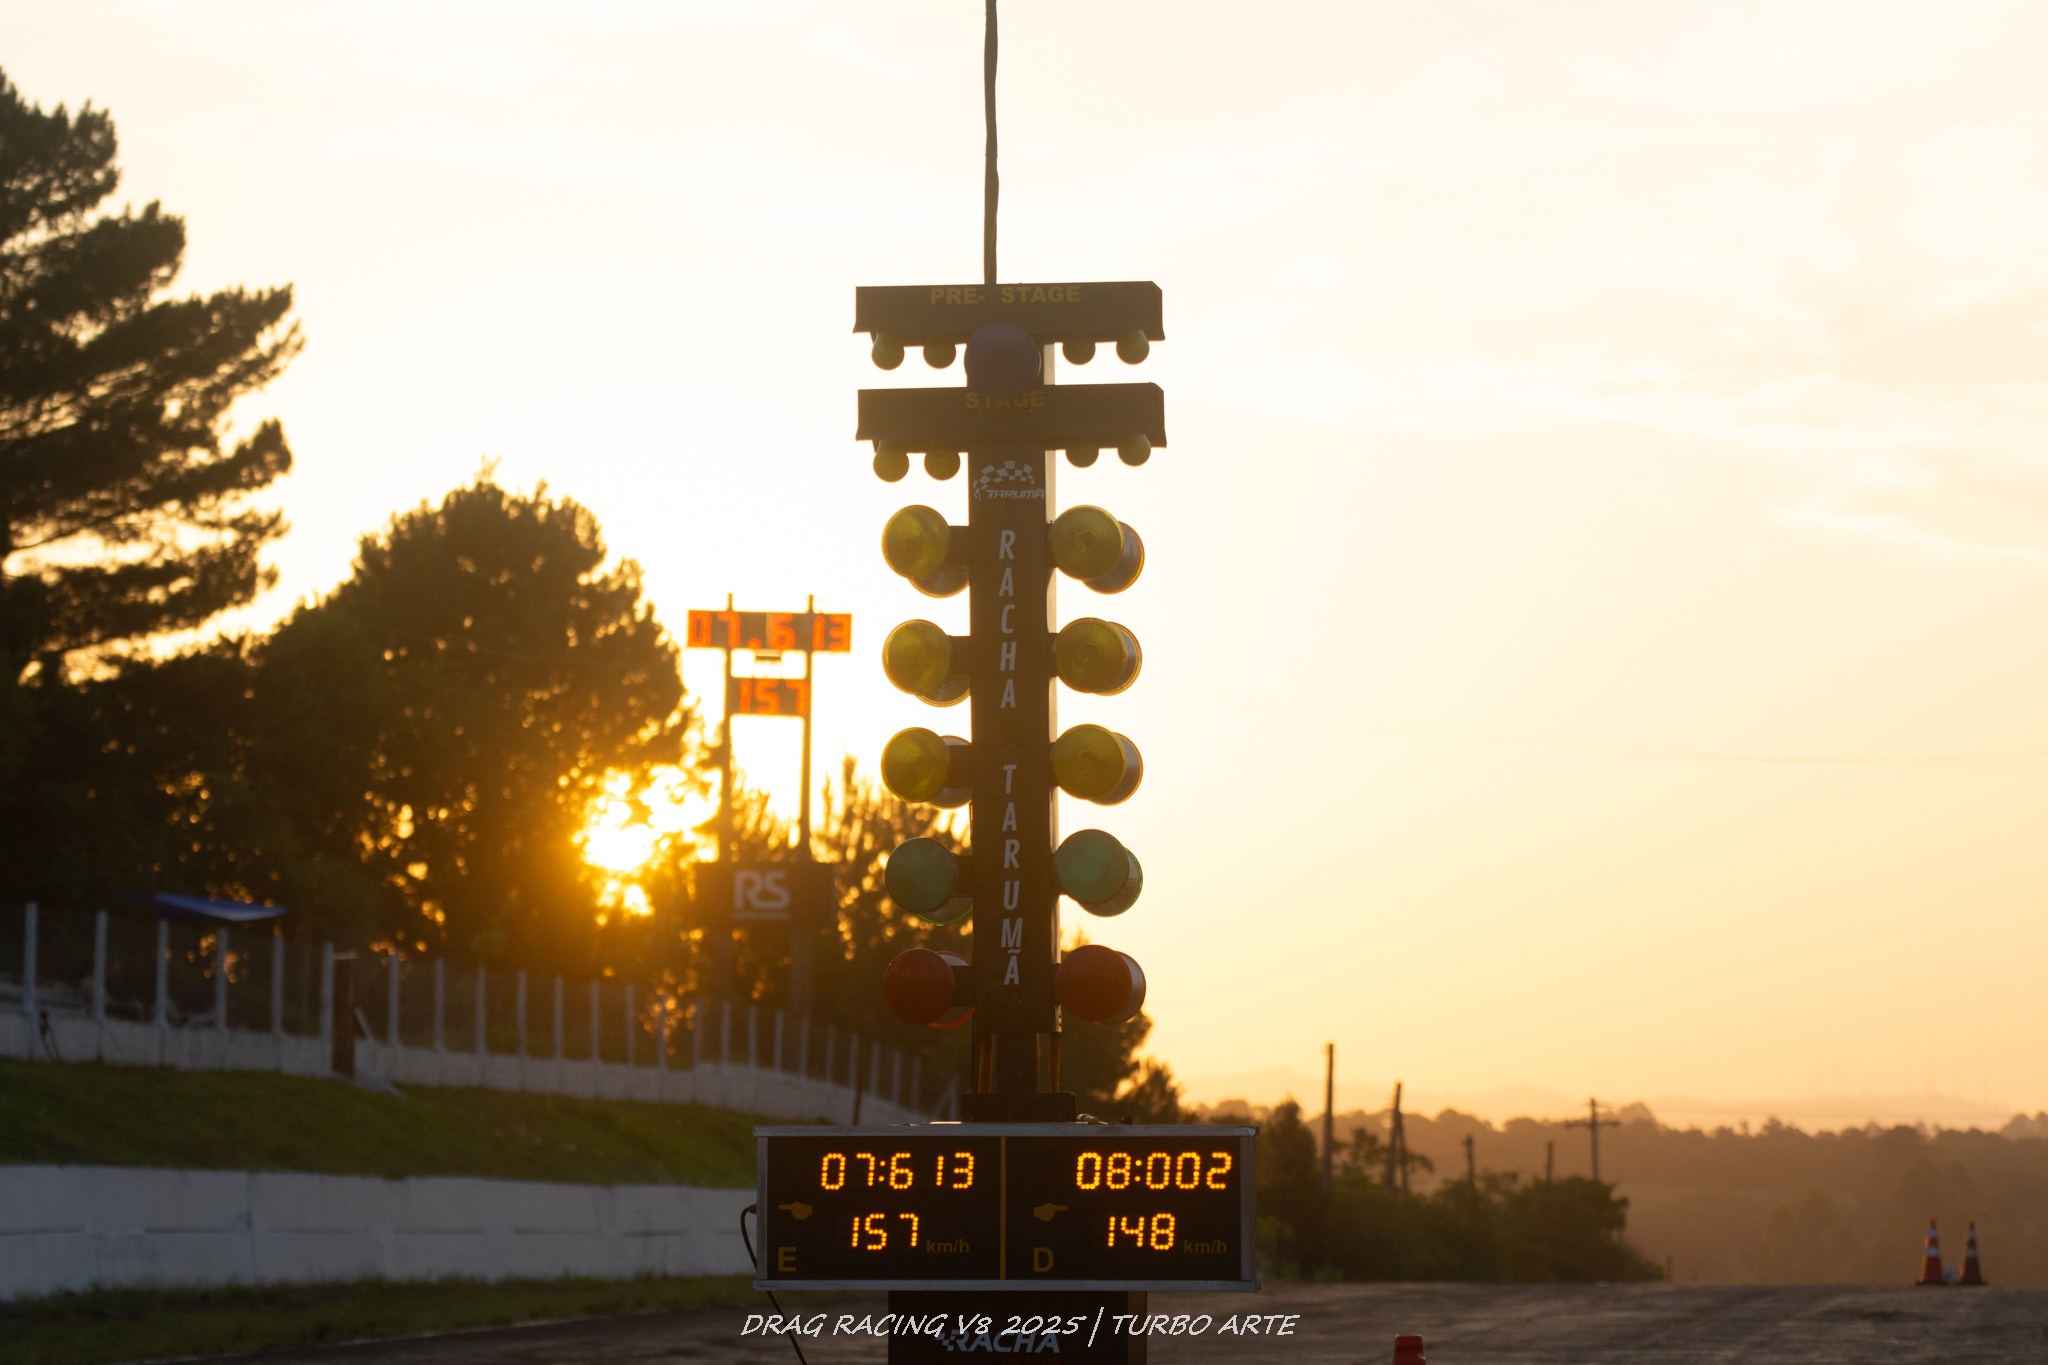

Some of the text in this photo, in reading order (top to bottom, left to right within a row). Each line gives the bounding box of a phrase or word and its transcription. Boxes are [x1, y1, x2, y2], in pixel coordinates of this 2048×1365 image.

[1000, 286, 1081, 304] STAGE
[739, 678, 809, 715] 157
[998, 530, 1023, 985] RACHA TARUMÃ
[733, 870, 791, 909] RS
[1076, 1152, 1232, 1190] 08:002
[850, 1213, 970, 1254] 157 km/h
[1107, 1213, 1228, 1254] 148 km/h
[778, 1247, 797, 1272] E
[1034, 1247, 1054, 1272] D
[943, 1329, 1060, 1353] RACHA
